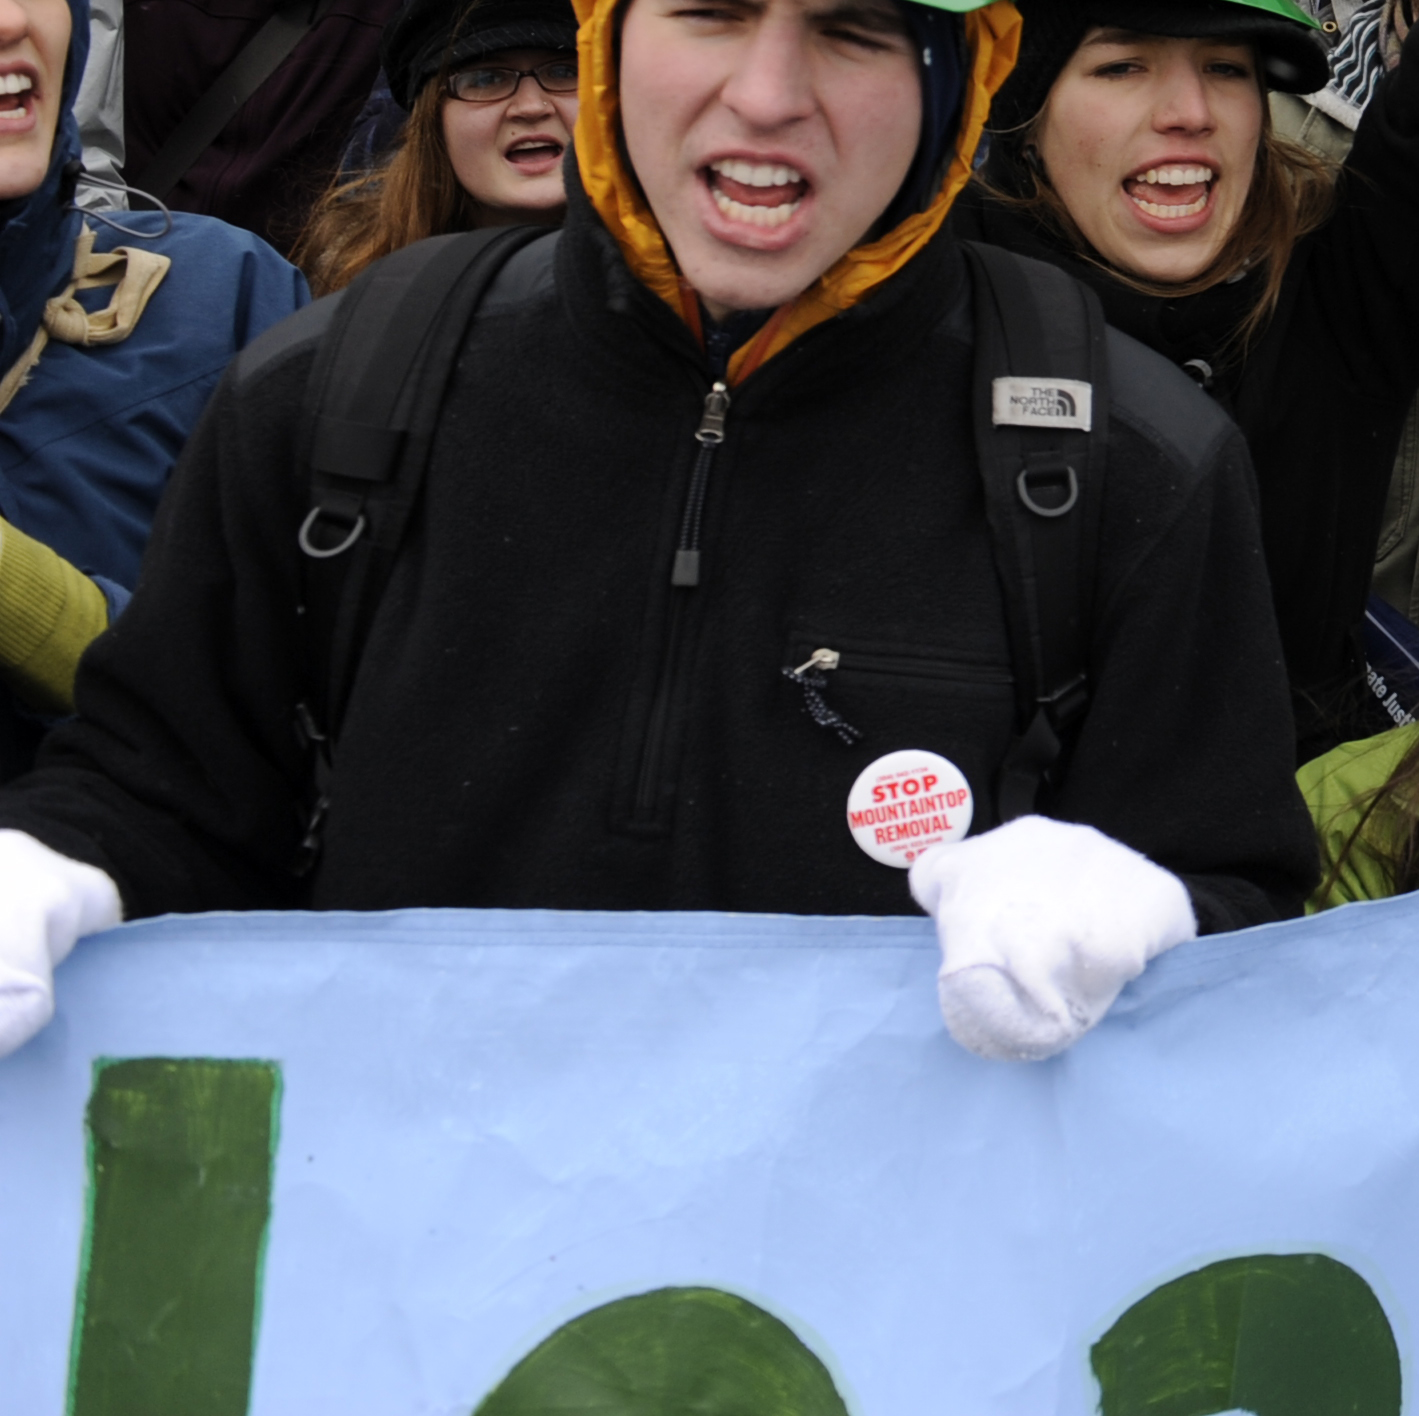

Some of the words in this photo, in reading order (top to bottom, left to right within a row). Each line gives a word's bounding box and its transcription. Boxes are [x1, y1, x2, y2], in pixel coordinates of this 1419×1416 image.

[1010, 396, 1057, 405] NORTH
[1031, 387, 1056, 397] THE
[1022, 407, 1056, 416] FACE
[872, 774, 937, 803] STOP
[850, 788, 967, 829] MOUNTAINTOP
[875, 814, 953, 845] REMOVAL
